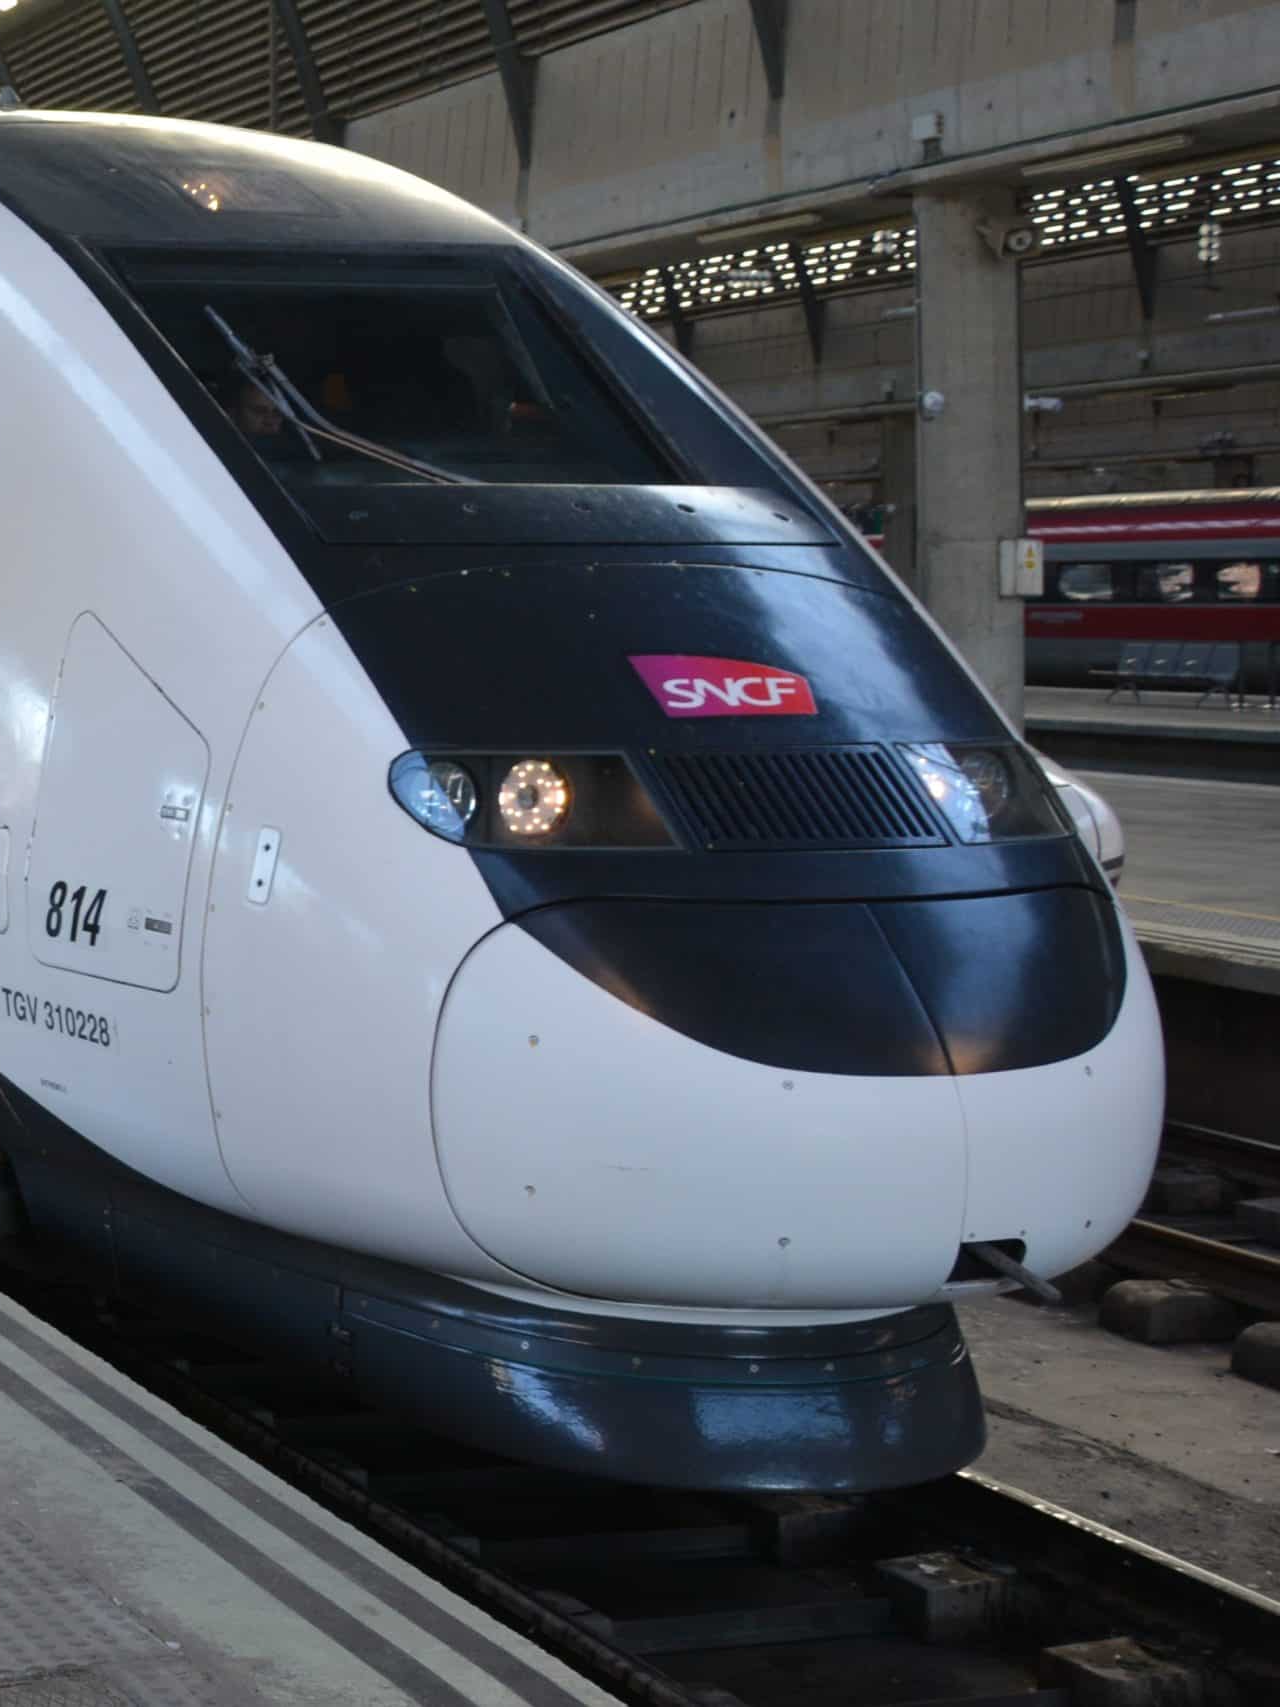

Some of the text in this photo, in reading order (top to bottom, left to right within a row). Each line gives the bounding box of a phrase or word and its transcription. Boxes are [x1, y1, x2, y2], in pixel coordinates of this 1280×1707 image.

[662, 677, 797, 709] SNCF
[46, 880, 107, 946] 814
[1, 987, 111, 1047] TGV 310228
